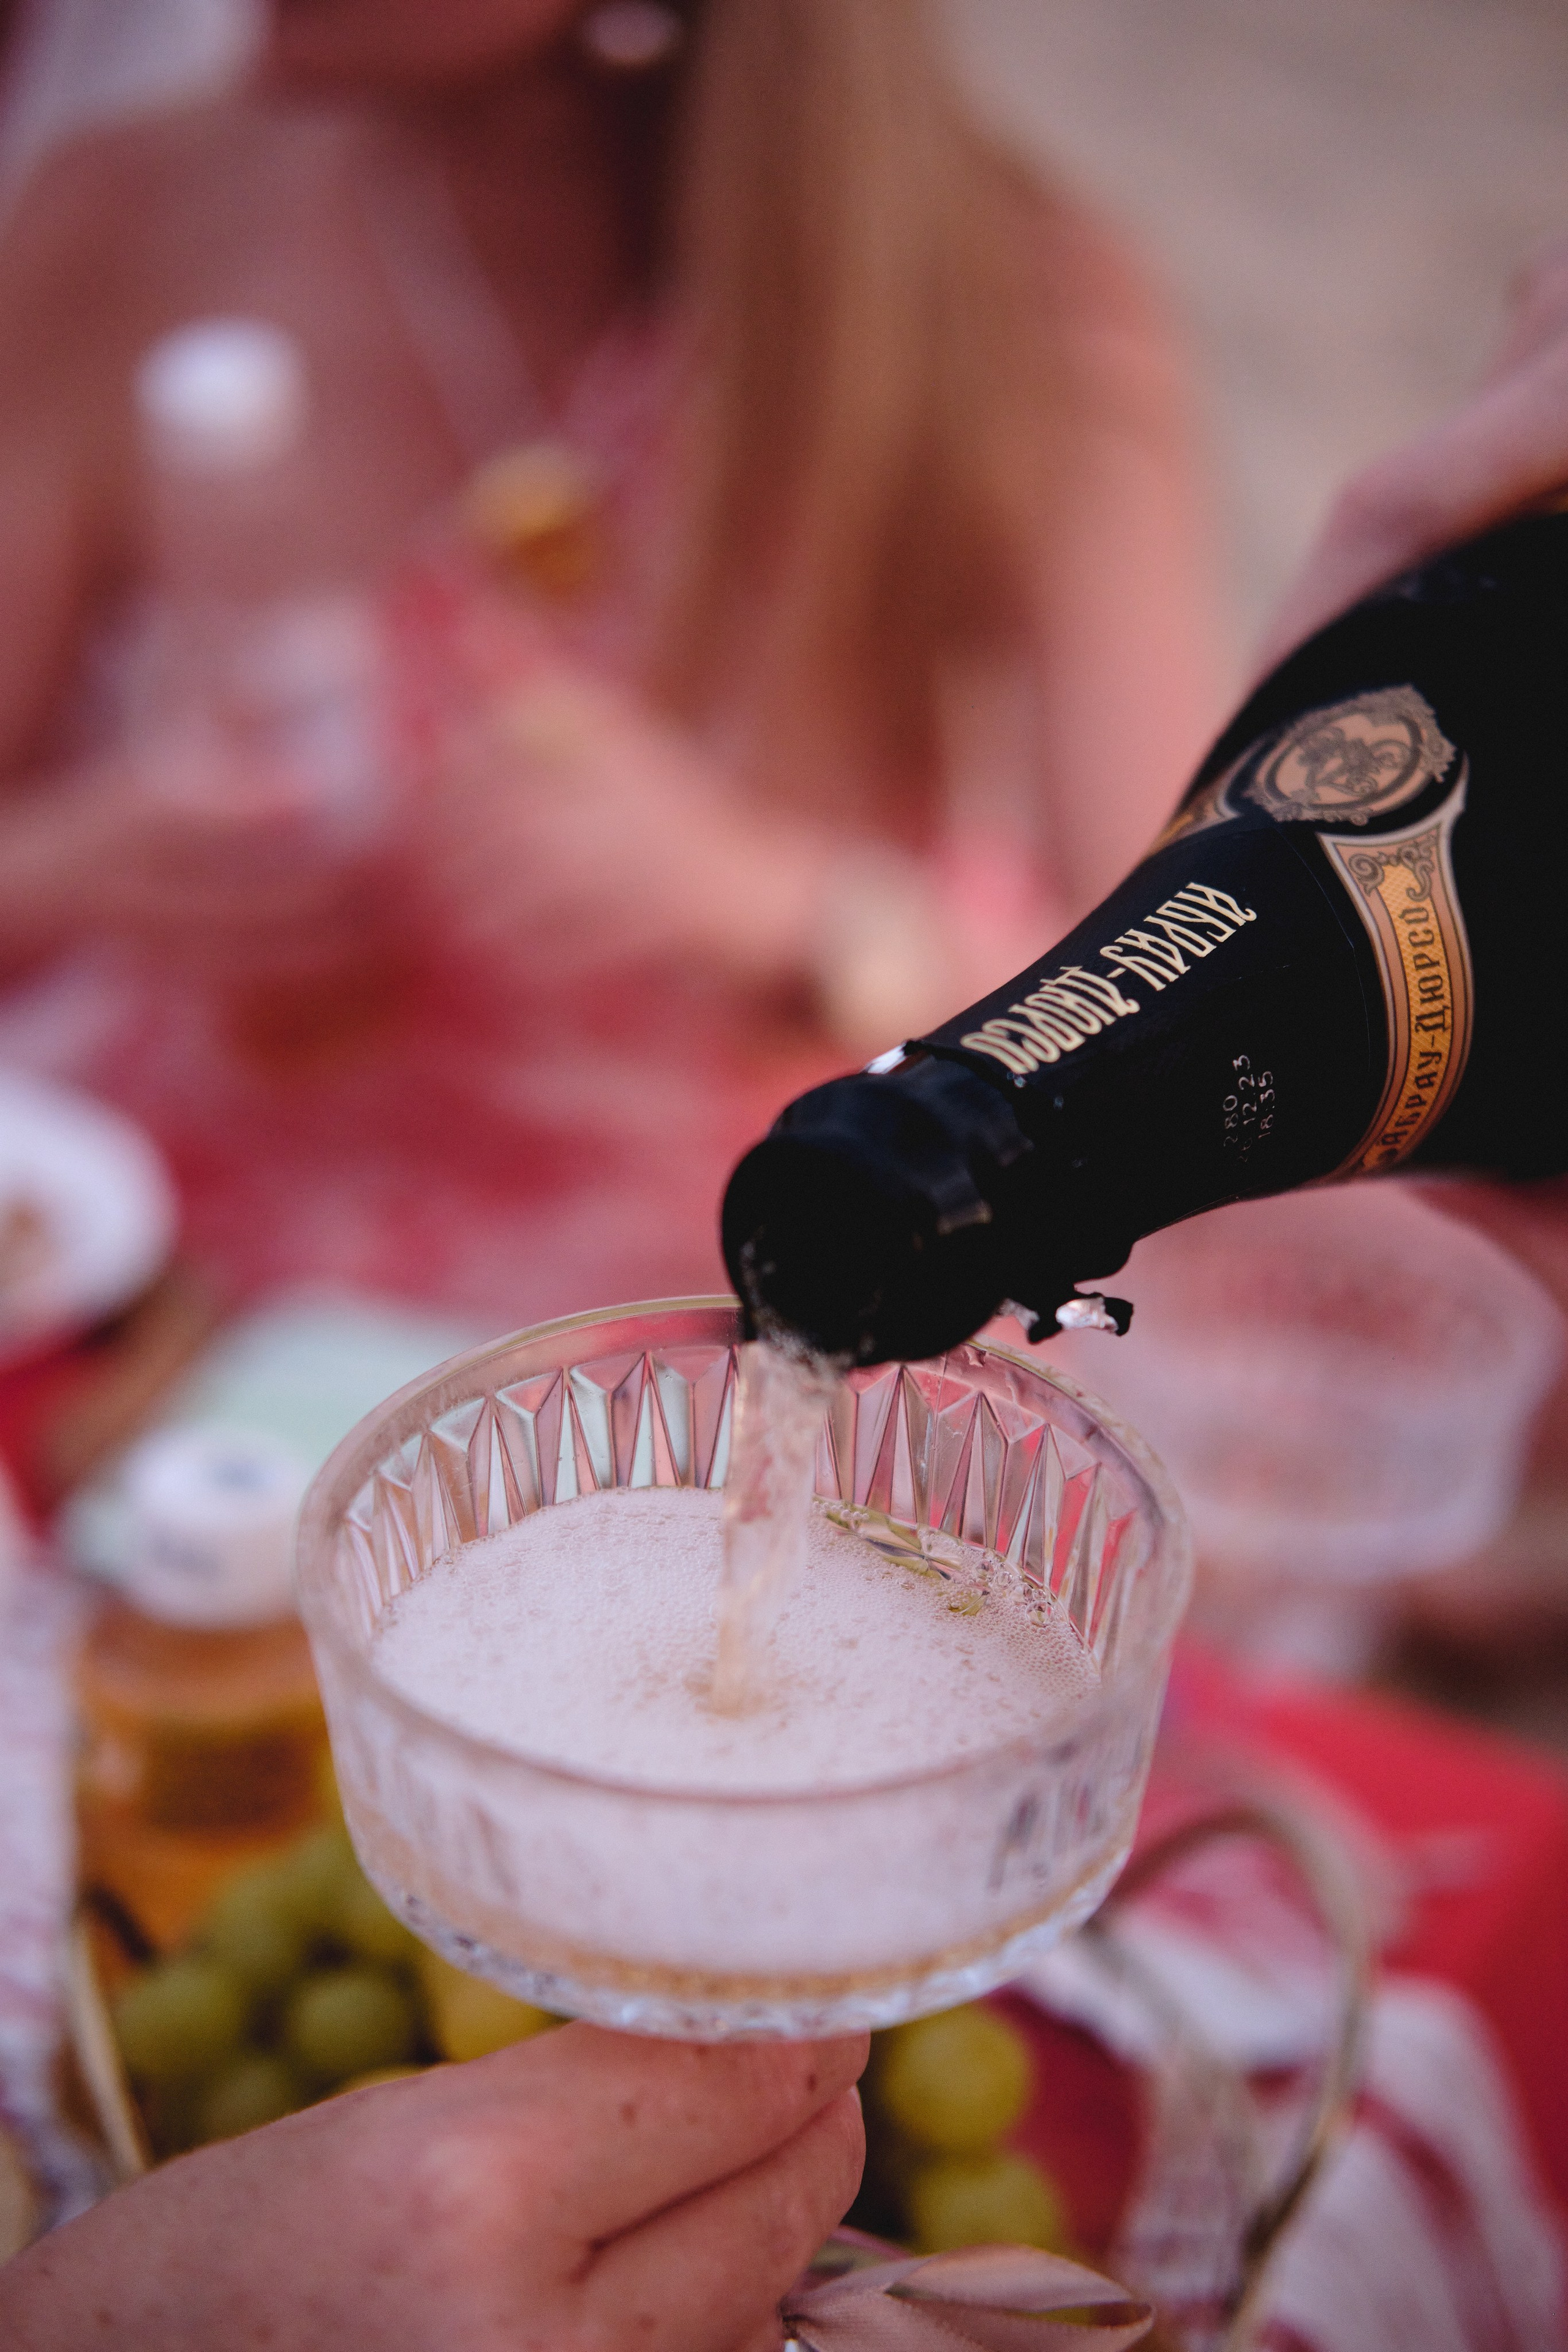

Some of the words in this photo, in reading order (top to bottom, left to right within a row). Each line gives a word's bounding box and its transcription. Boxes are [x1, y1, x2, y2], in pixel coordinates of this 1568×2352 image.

[960, 882, 1257, 1074] АБРАУ-ДЮРСО
[1381, 905, 1452, 1145] АБРАУ-ДЮРСО
[1257, 1071, 1275, 1140] 18:35
